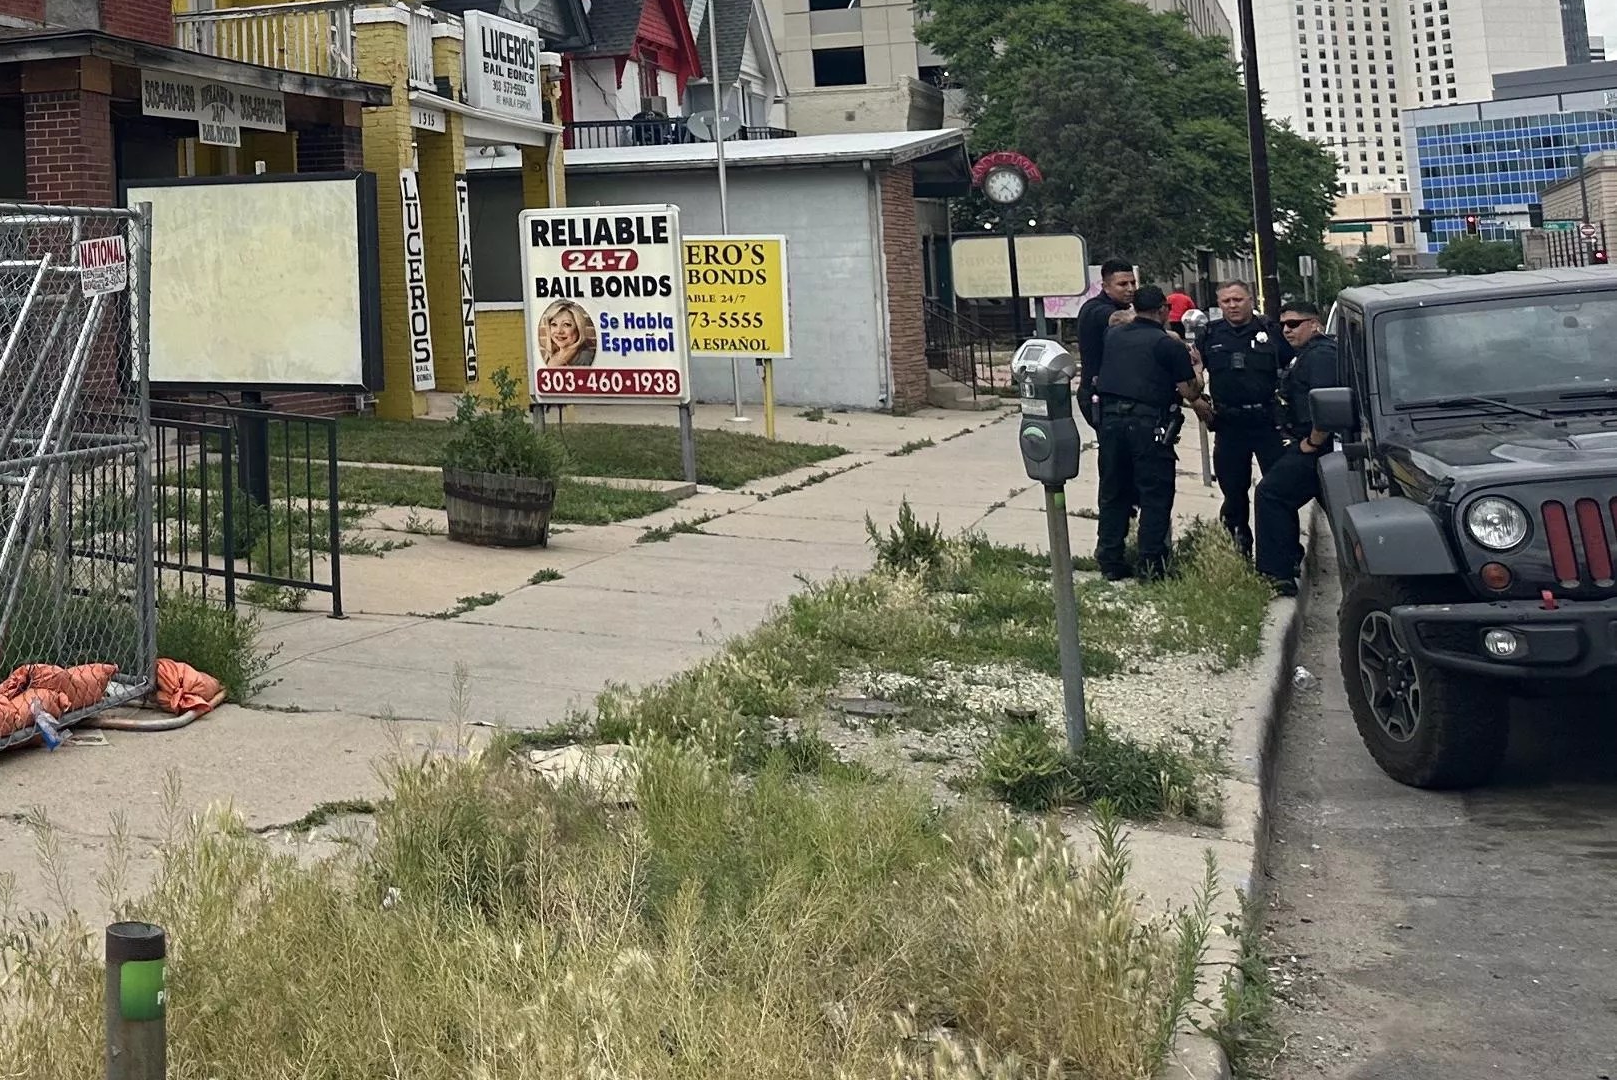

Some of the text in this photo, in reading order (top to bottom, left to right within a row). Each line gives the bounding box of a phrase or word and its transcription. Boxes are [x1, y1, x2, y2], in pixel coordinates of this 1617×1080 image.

[482, 26, 535, 70] LUCERO'S
[483, 62, 504, 77] BAIL
[530, 215, 669, 247] RELIABLE
[80, 238, 124, 269] NATIONAL
[568, 251, 631, 270] 24-7
[685, 243, 765, 265] ERO'S
[403, 177, 431, 364] LUCEROS
[686, 269, 767, 285] BONDS
[457, 186, 477, 381] FIANZAS
[535, 275, 672, 298] BAIL BONDS
[720, 294, 746, 304] 24/7
[599, 311, 674, 329] Se Habla
[688, 311, 763, 328] 73-5555
[601, 332, 675, 356] Español
[703, 336, 770, 351] ESPAÑOL
